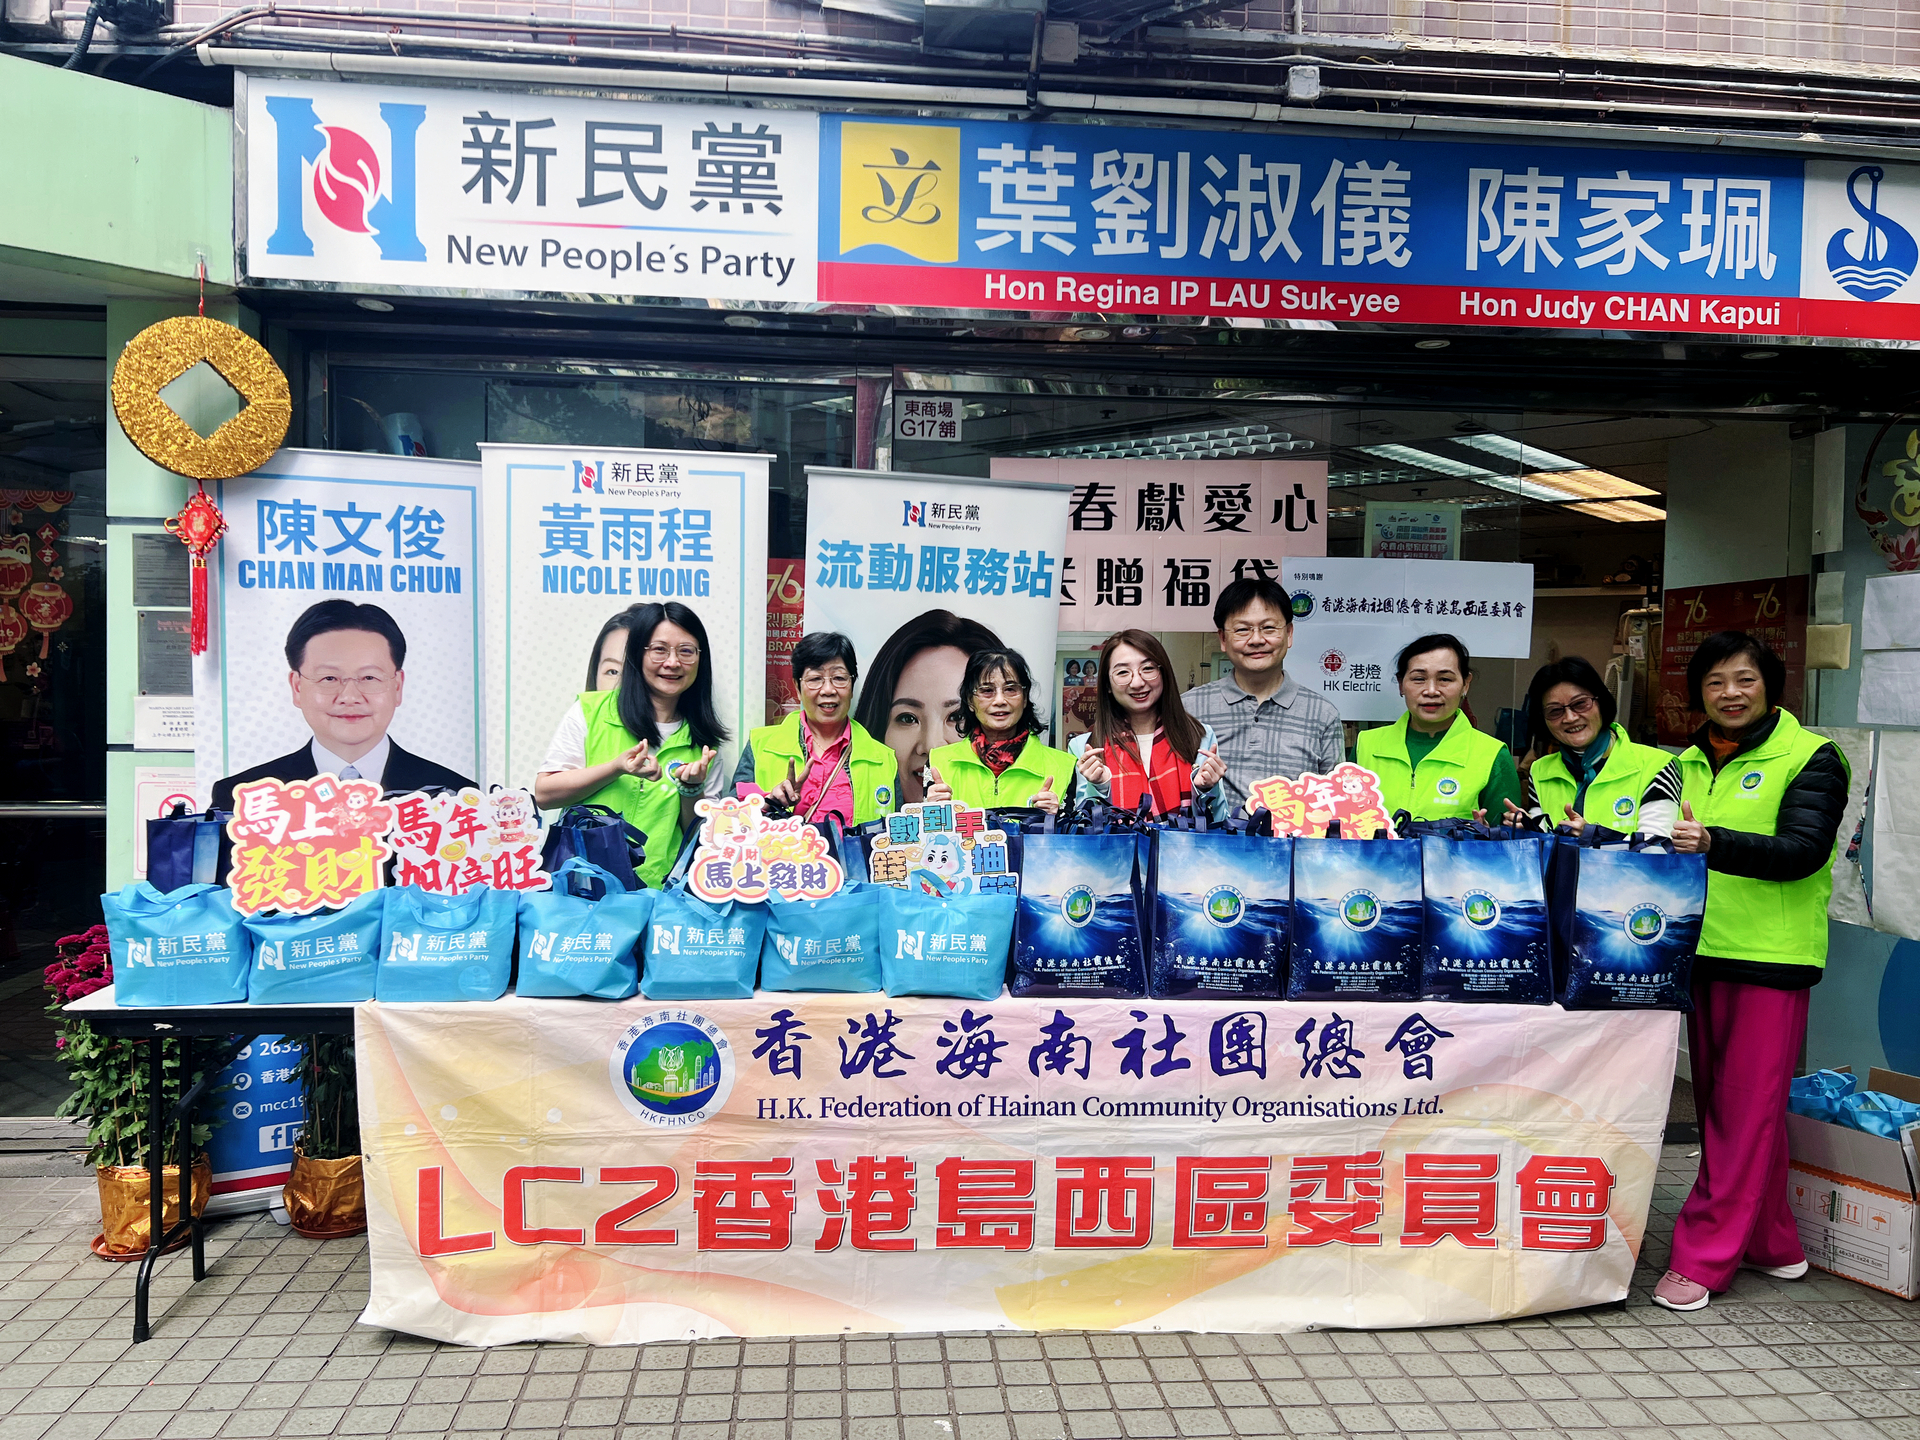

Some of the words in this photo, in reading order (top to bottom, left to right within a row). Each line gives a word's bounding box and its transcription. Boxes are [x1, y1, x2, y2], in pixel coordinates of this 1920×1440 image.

[461, 110, 784, 216] 新民黨
[974, 142, 1413, 269] 葉劉淑儀
[1465, 166, 1778, 282] 陳家珮
[446, 234, 529, 268] New
[700, 246, 796, 286] Party
[984, 273, 1045, 302] Hon
[1055, 275, 1160, 309] Regina
[1170, 281, 1200, 306] IP
[1209, 282, 1271, 310] LAU
[1280, 285, 1401, 317] Suk-yee
[1459, 290, 1518, 318] Hon
[1525, 294, 1596, 326] Judy
[1604, 296, 1690, 323] CHAN
[1699, 299, 1781, 330] Kapui
[904, 400, 953, 418] 東商場
[611, 461, 679, 484] 新民黨
[608, 488, 625, 496] New
[661, 490, 682, 499] Party
[1068, 482, 1319, 533] 春獻愛心
[931, 502, 980, 521] 新民黨
[256, 498, 446, 560] 陳文俊
[539, 503, 714, 563] 黃雨程
[238, 560, 316, 590] CHAN
[322, 562, 384, 592] MAN
[390, 564, 462, 594] CHUN
[542, 565, 632, 596] NICOLE
[638, 567, 710, 597] WONG
[815, 538, 1055, 598] 流動服務站
[1294, 573, 1324, 581] 特別鳴謝
[767, 564, 803, 604] 76
[1684, 590, 1708, 628] 76
[1753, 583, 1781, 624] 76
[1323, 680, 1340, 691] HK
[1343, 680, 1382, 692] Electric
[1349, 664, 1382, 679] 港燈
[237, 786, 335, 846] 馬上
[1259, 779, 1347, 827] 馬年
[394, 797, 488, 856] 馬年
[760, 818, 799, 834] 2026
[237, 836, 383, 909] 發財
[398, 845, 547, 896] 加倍旺
[705, 861, 828, 890] 馬上發財
[157, 932, 227, 956] 新民黨
[291, 932, 359, 958] 新民黨
[426, 930, 487, 951] 新民黨
[687, 926, 745, 945] 新民黨
[804, 934, 862, 955] 新民黨
[929, 933, 987, 952] 新民黨
[341, 955, 362, 963] Party
[594, 956, 611, 964] Party
[729, 950, 746, 958] Party
[971, 957, 988, 965] Party
[617, 1010, 728, 1051] 香港海南社團總會
[752, 1008, 1455, 1082] 香港海南社團總會
[260, 1067, 302, 1083] 香港
[640, 1109, 705, 1126] HKFHNCO
[757, 1097, 812, 1119] H.K.
[819, 1095, 952, 1118] Federation
[958, 1094, 985, 1117] of
[987, 1095, 1077, 1117] Hainan
[1082, 1094, 1227, 1123] Community
[1231, 1094, 1397, 1123] Organisations
[1401, 1095, 1444, 1116] Ltd.
